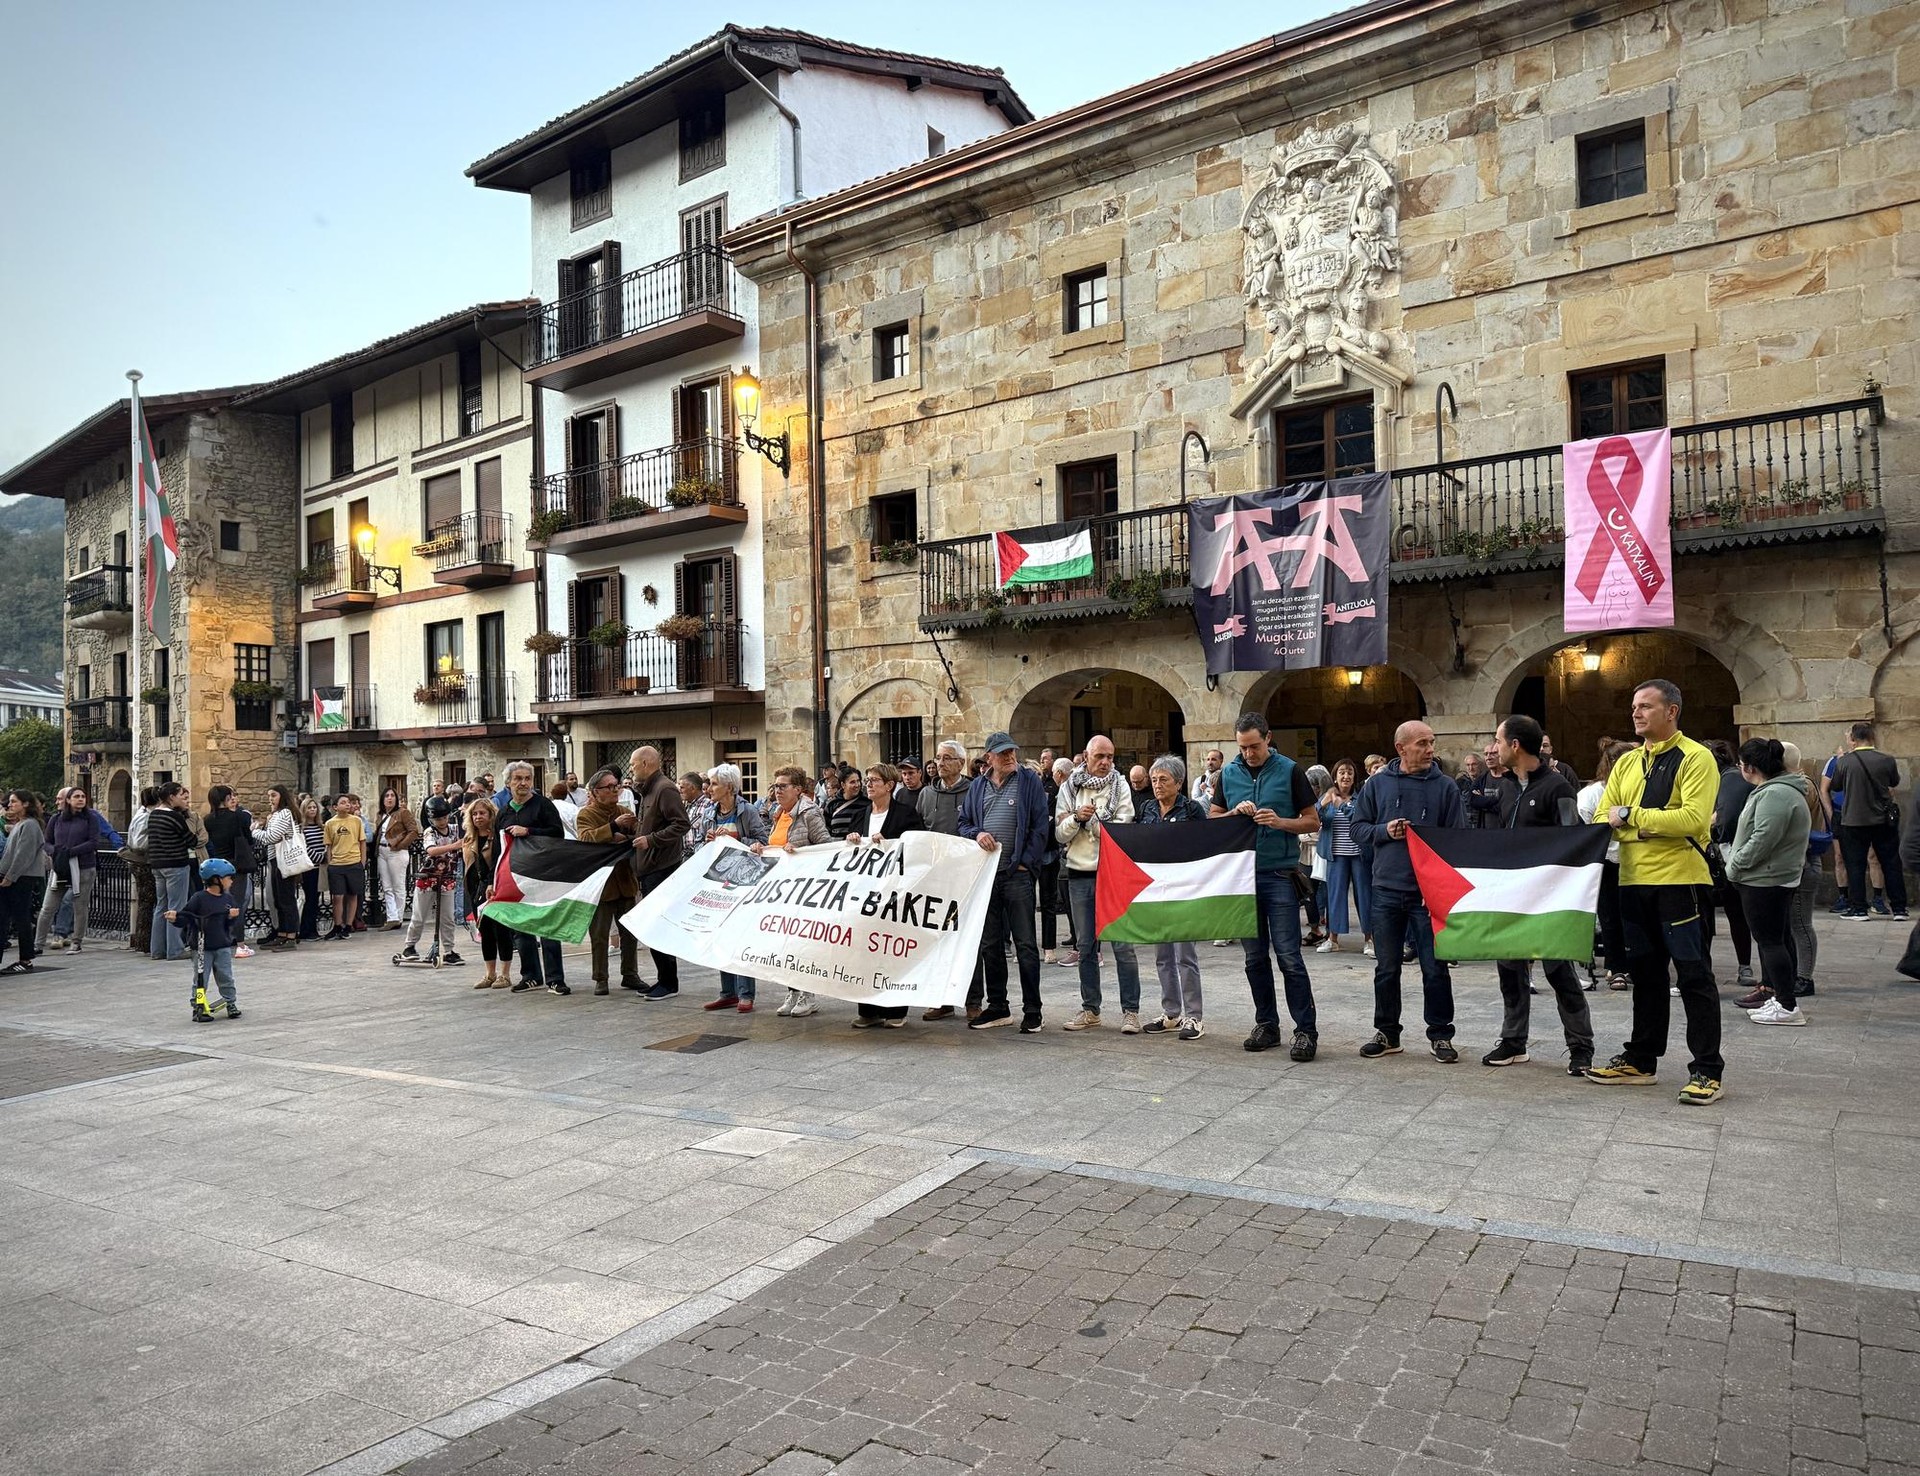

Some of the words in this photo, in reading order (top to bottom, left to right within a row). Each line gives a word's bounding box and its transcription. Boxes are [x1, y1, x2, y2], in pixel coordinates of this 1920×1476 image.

[1620, 531, 1659, 588] KATXALIN
[1267, 596, 1293, 604] dezagun
[1336, 597, 1376, 613] ANTZUOLA
[1256, 606, 1278, 614] mugari
[1273, 622, 1291, 630] eskua
[1255, 631, 1294, 645] Mugak
[1296, 627, 1317, 641] Zubi
[1273, 647, 1287, 655] 40
[1288, 647, 1306, 655] urte
[759, 914, 852, 947] GENOZIDIOA
[868, 932, 918, 958] STOP
[784, 954, 829, 978] Palestina
[832, 964, 865, 986] Herri
